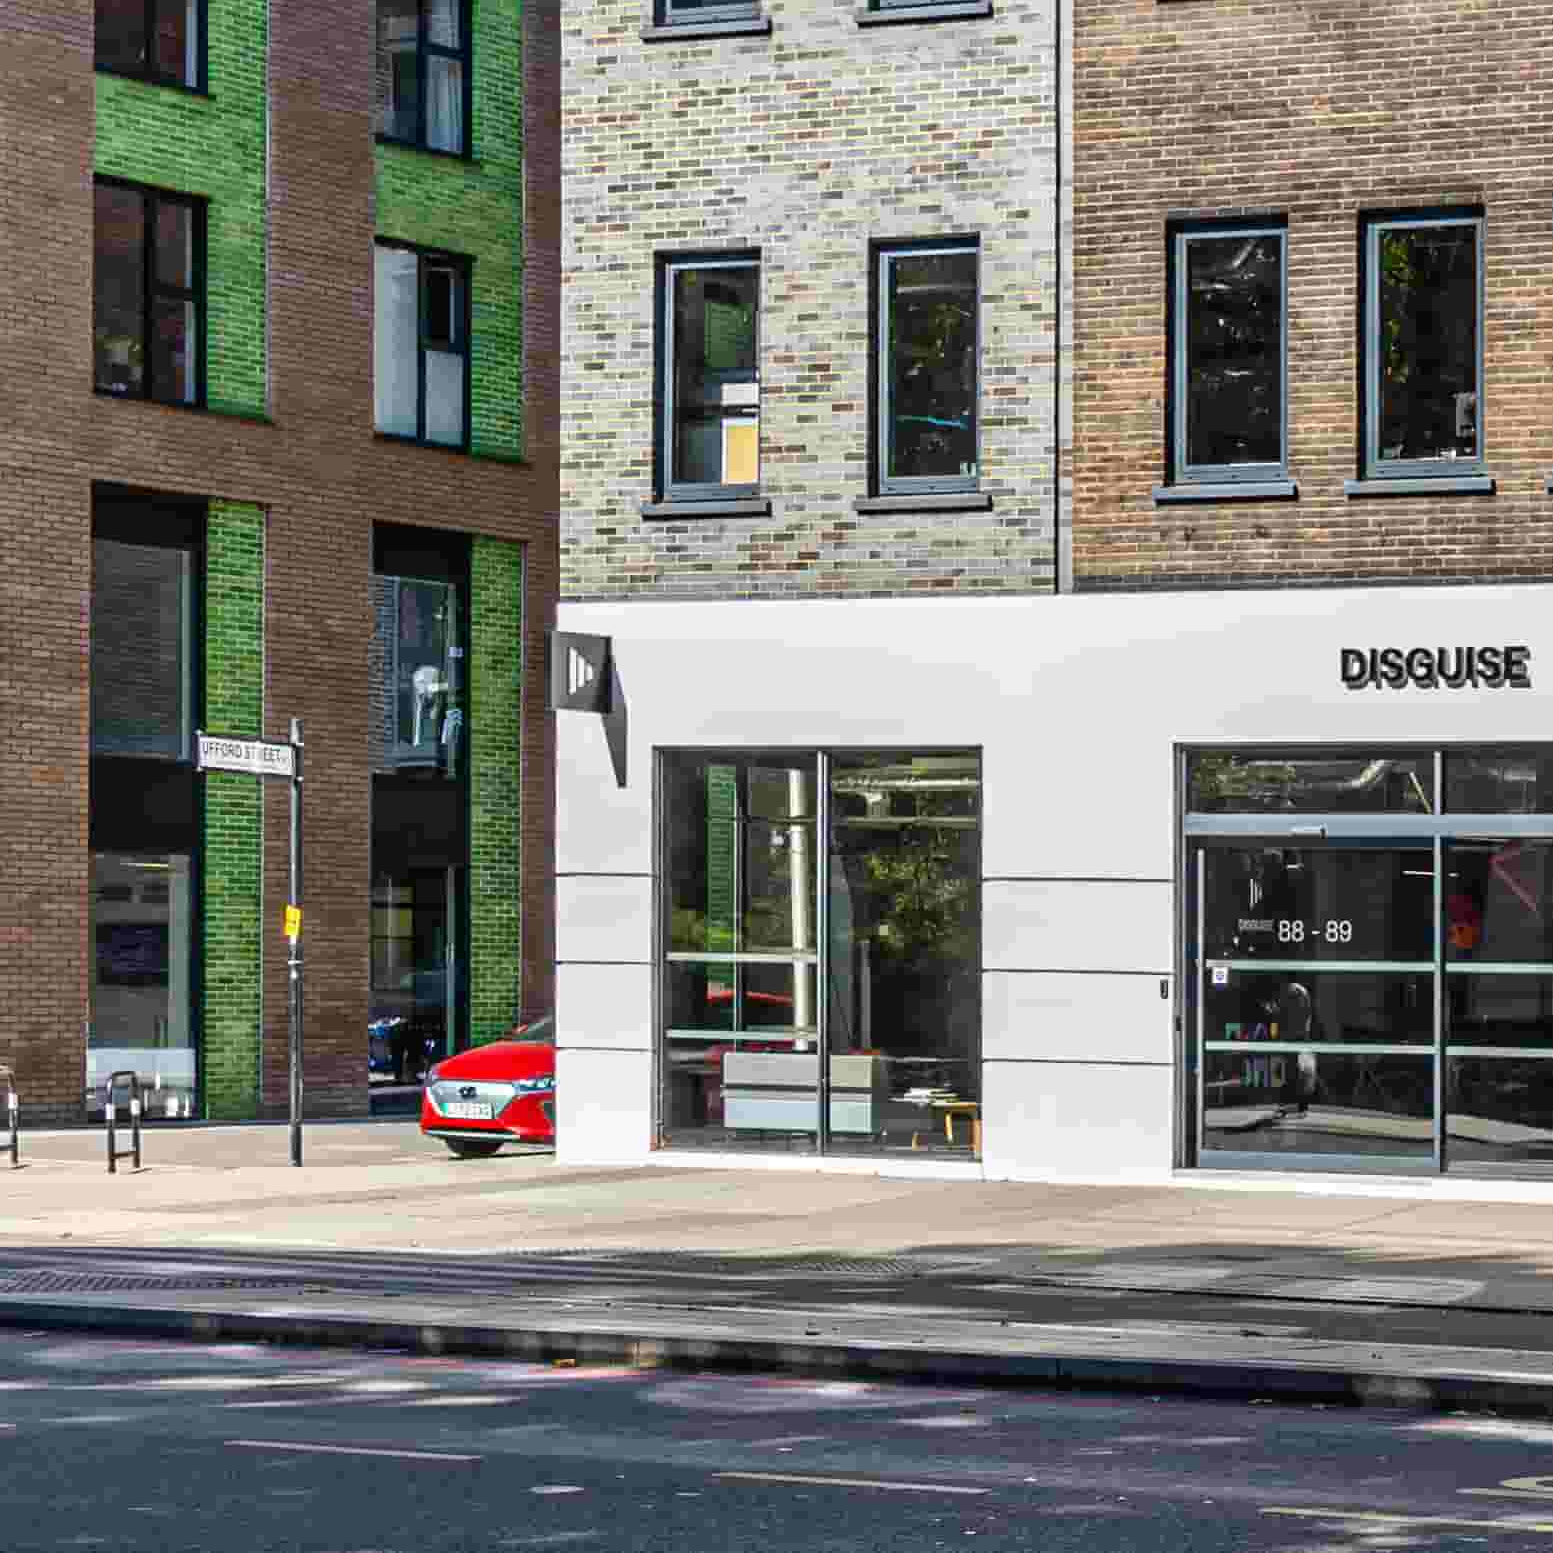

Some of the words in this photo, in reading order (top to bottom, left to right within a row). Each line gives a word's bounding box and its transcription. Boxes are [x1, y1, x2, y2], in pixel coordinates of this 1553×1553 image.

[1340, 645, 1532, 689] DISGUISE
[202, 741, 242, 759] UFFORD
[244, 745, 281, 762] STEET
[1278, 919, 1304, 943] 88
[1325, 919, 1352, 943] 89
